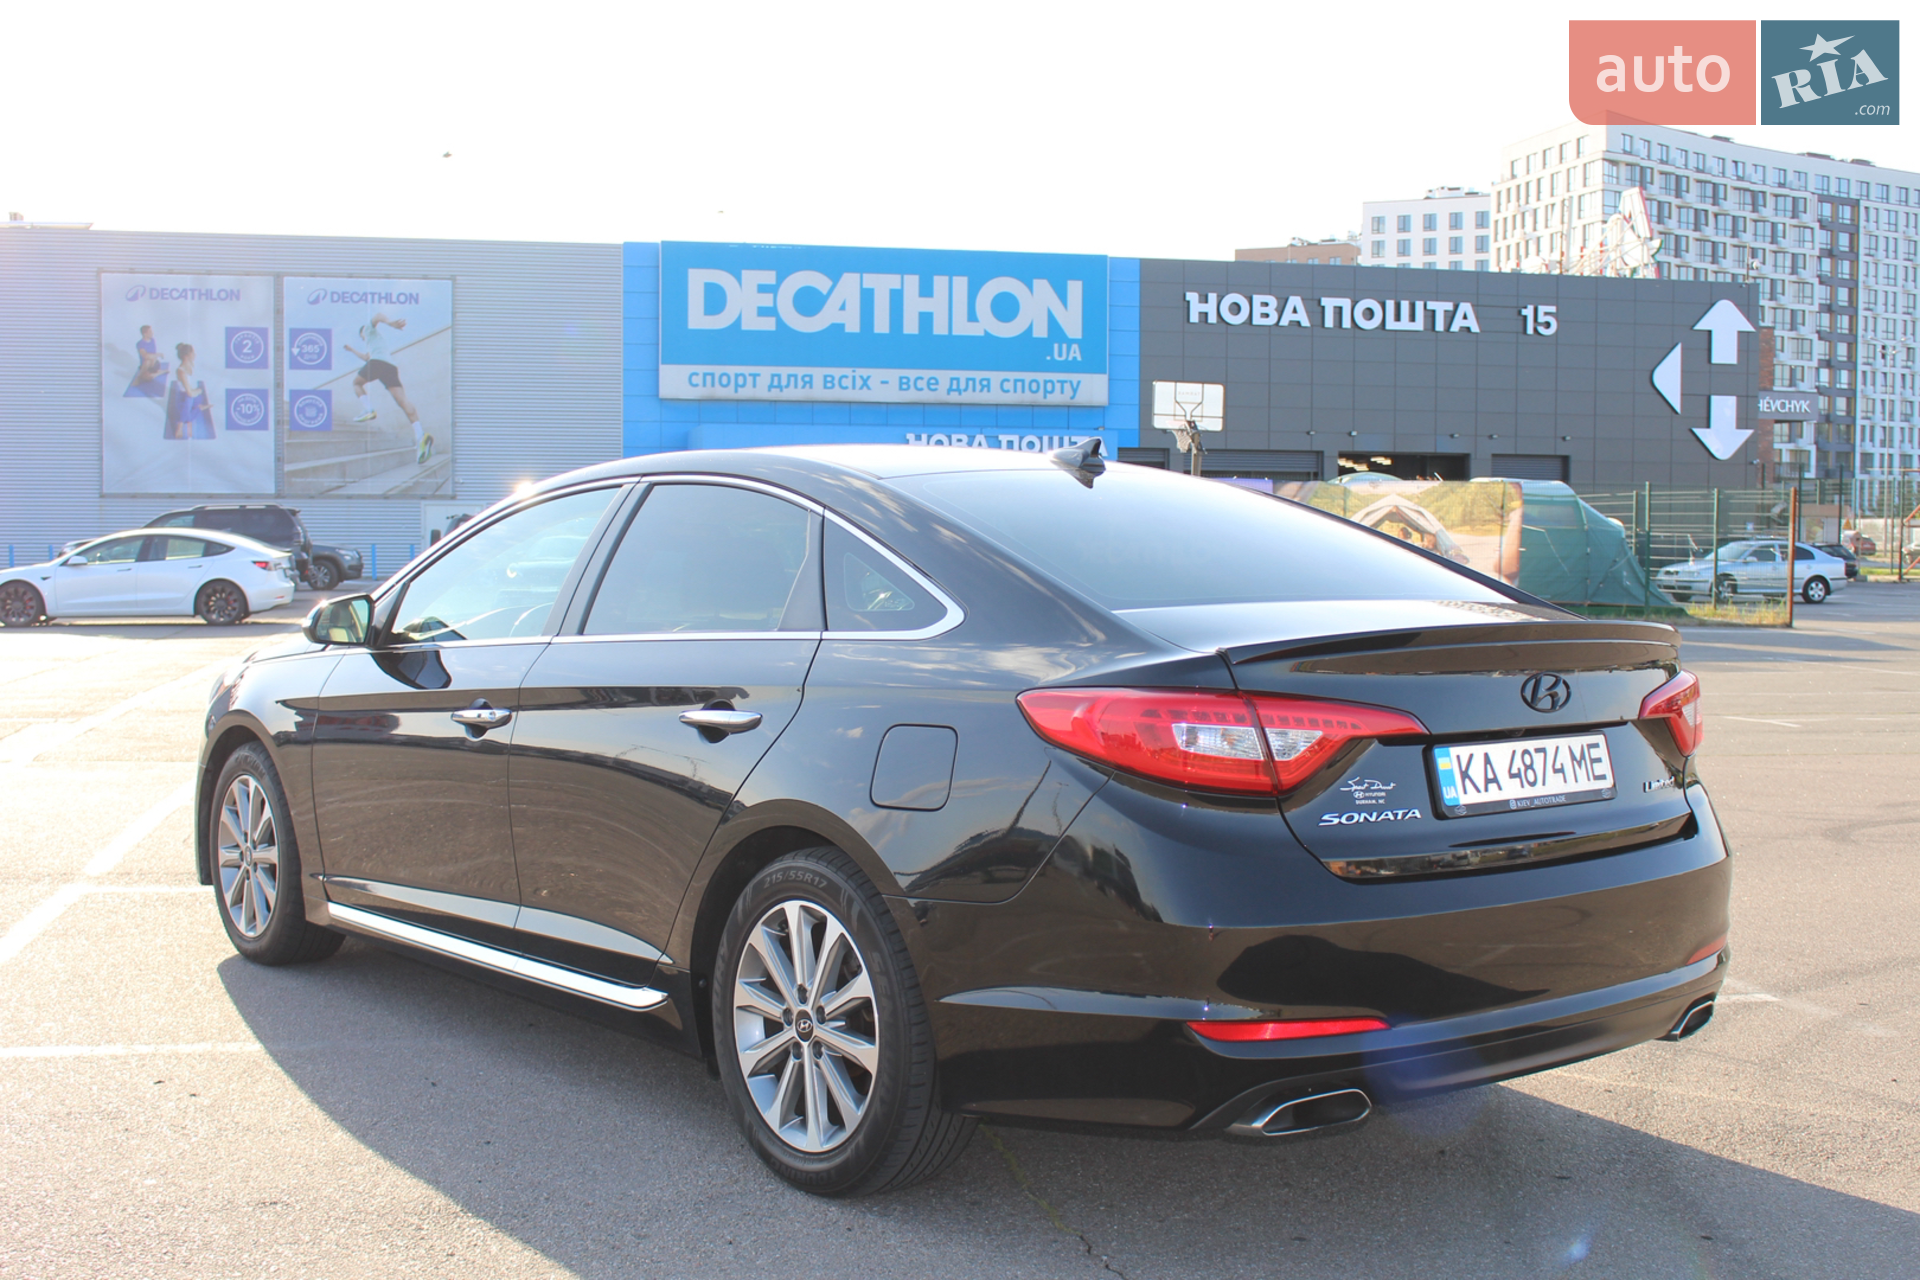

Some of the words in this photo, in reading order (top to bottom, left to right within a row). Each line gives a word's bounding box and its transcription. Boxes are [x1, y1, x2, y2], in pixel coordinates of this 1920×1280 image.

[148, 287, 241, 302] DECATHLON
[330, 290, 420, 305] DECATHLON
[687, 268, 1083, 339] DECATHLON
[1185, 292, 1311, 328] НОВА
[1320, 297, 1481, 333] ПОШТА
[1519, 304, 1558, 336] 15
[242, 339, 253, 353] 2
[301, 344, 320, 353] 365
[1046, 343, 1082, 361] .UA
[688, 371, 761, 394] спорт
[767, 373, 814, 392] для
[823, 369, 872, 391] всіх
[898, 375, 940, 392] все
[947, 376, 991, 396] для
[999, 378, 1082, 400] спорту
[1456, 752, 1502, 795] KA
[1508, 747, 1567, 789] 4874
[1569, 742, 1608, 783] ME
[1443, 786, 1457, 799] UA
[1318, 808, 1422, 827] SONATA
[763, 870, 828, 889] 215/55R17
